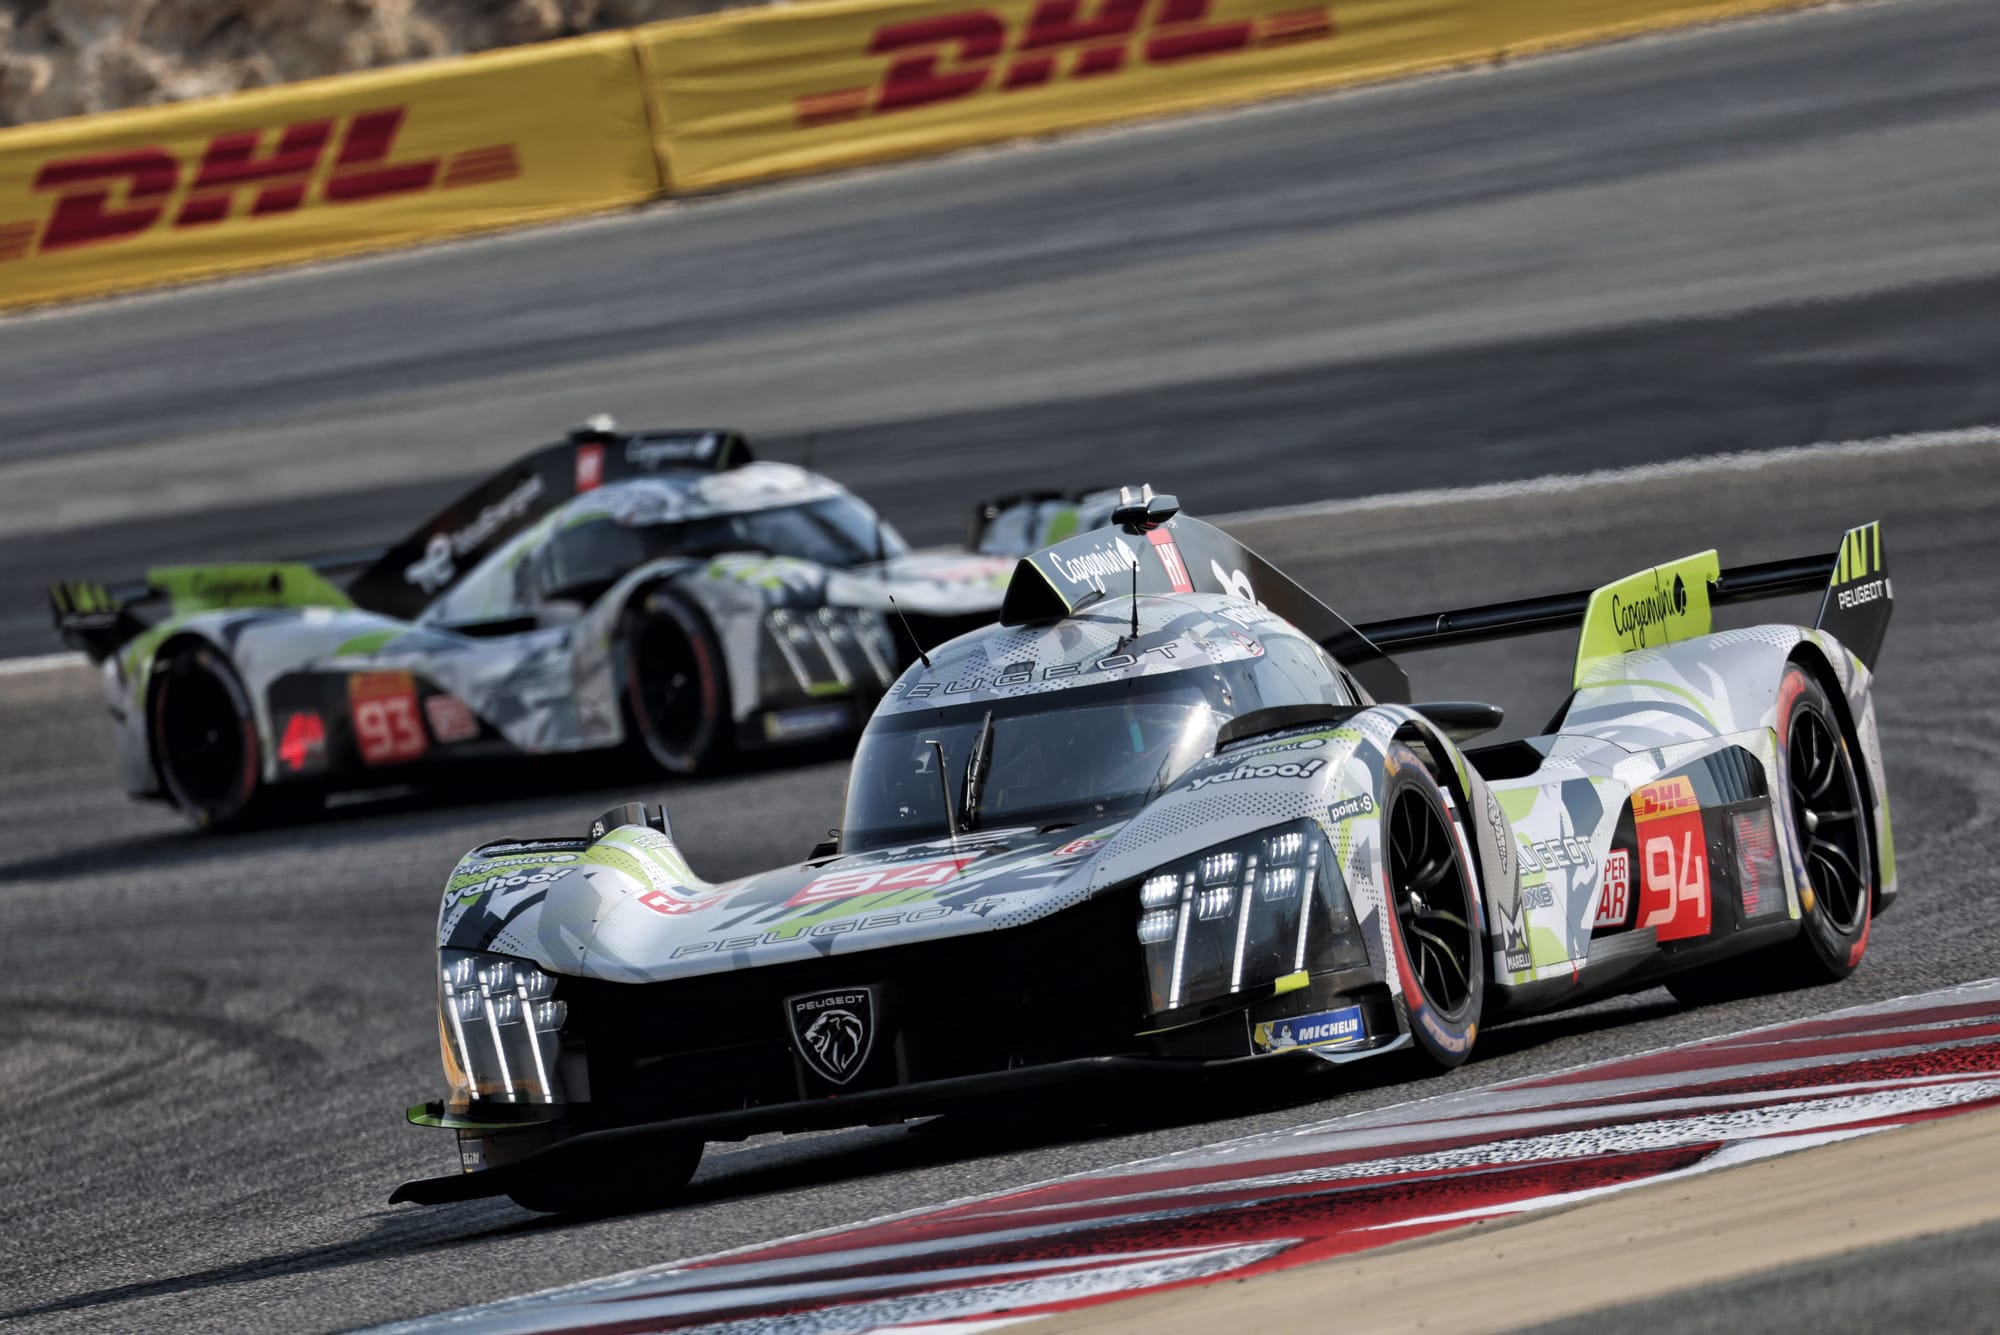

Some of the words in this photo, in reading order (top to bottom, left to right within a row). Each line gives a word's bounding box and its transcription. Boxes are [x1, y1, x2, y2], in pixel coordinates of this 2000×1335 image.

[866, 0, 1254, 112] DHL
[32, 105, 441, 253] DHL
[1050, 544, 1123, 593] Capgemini
[1612, 578, 1676, 648] Capgemini
[1838, 580, 1883, 610] PEUGEOT
[356, 698, 427, 760] 93
[1187, 759, 1328, 792] yahoo!
[1332, 804, 1359, 822] point
[1641, 783, 1688, 815] DHL
[446, 868, 575, 910] yahoo!
[799, 862, 950, 903] 94
[1604, 857, 1626, 882] PER
[1644, 831, 1706, 927] 94
[1596, 882, 1626, 921] AR
[669, 897, 1006, 960] PEUGEOT
[1507, 953, 1531, 971] MARELLI
[796, 995, 864, 1013] PEUGEOT
[1299, 1018, 1358, 1042] MICHELIN
